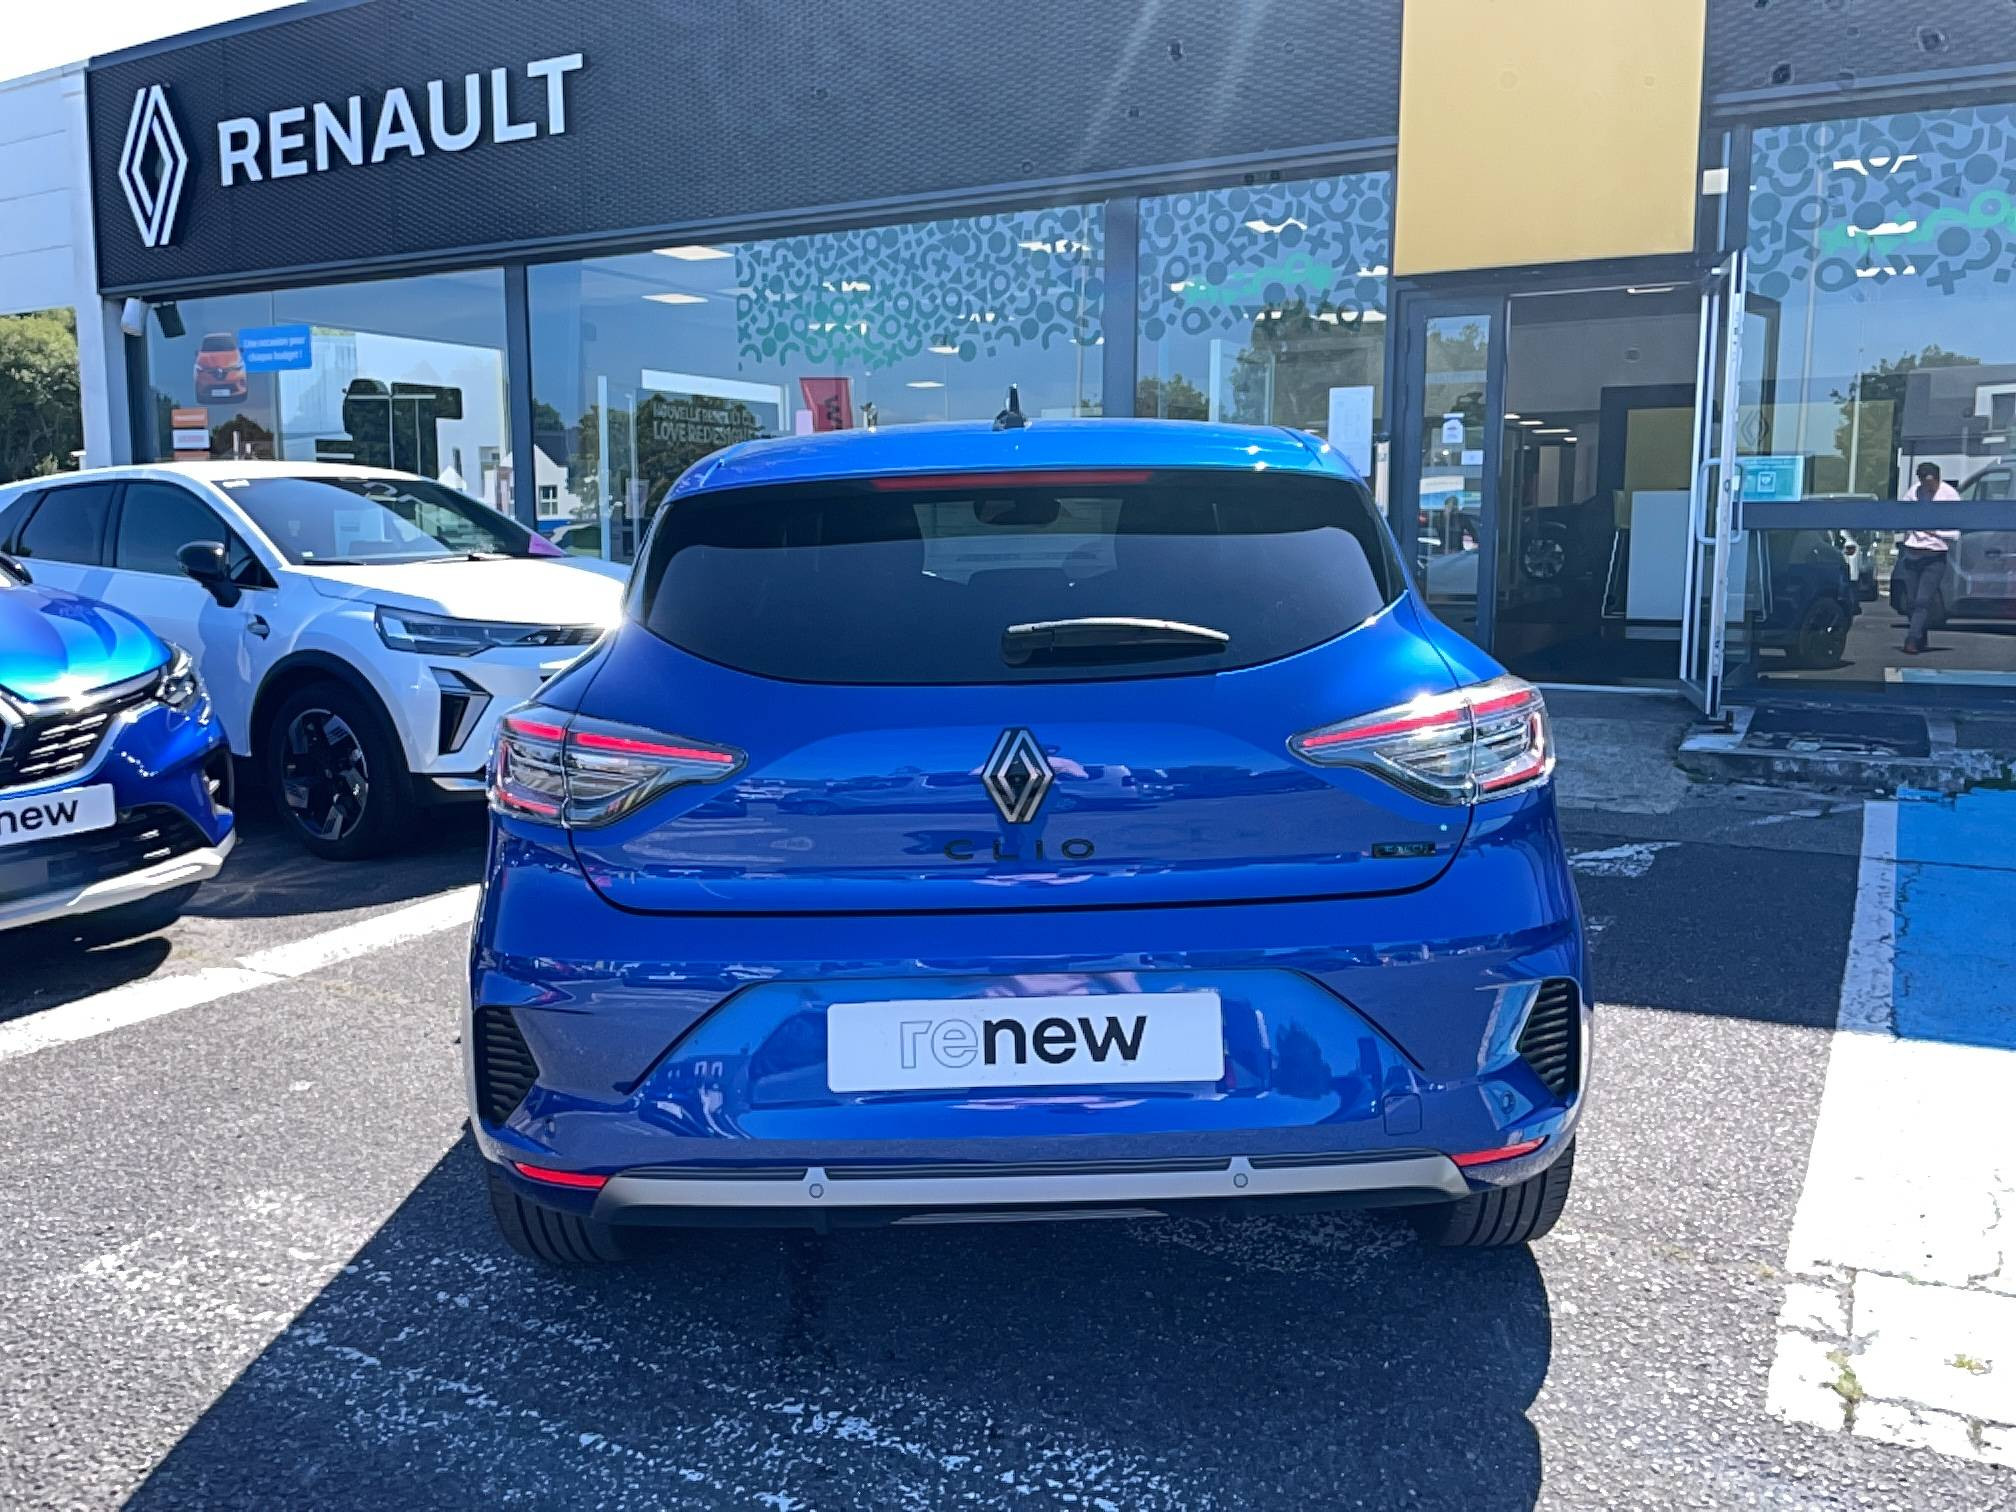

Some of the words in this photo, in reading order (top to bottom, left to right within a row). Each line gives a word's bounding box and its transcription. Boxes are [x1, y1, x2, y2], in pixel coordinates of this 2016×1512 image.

[218, 53, 584, 187] RENAULT
[944, 838, 1095, 860] CLIO
[900, 1015, 1148, 1069] renew
